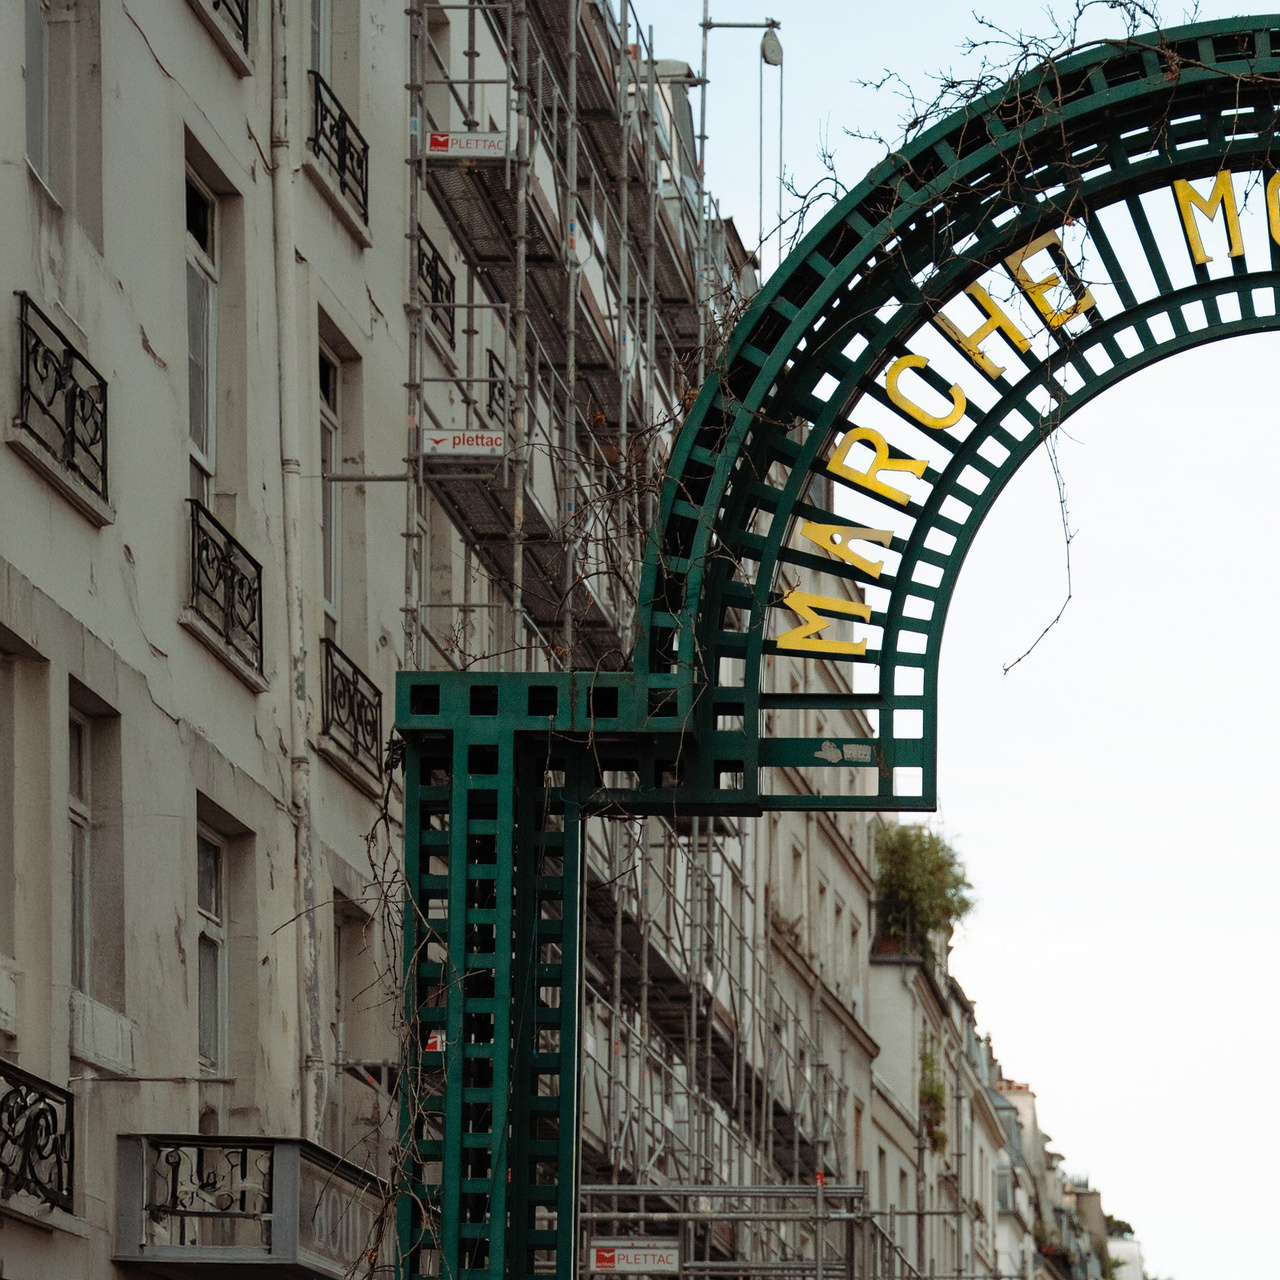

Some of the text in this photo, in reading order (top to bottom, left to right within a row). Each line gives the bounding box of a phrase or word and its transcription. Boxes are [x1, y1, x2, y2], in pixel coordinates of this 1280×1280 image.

[451, 138, 504, 151] PLETTAC
[452, 432, 503, 449] plettac
[777, 229, 1097, 656] MARCHE
[617, 1253, 674, 1265] PLETTAC
